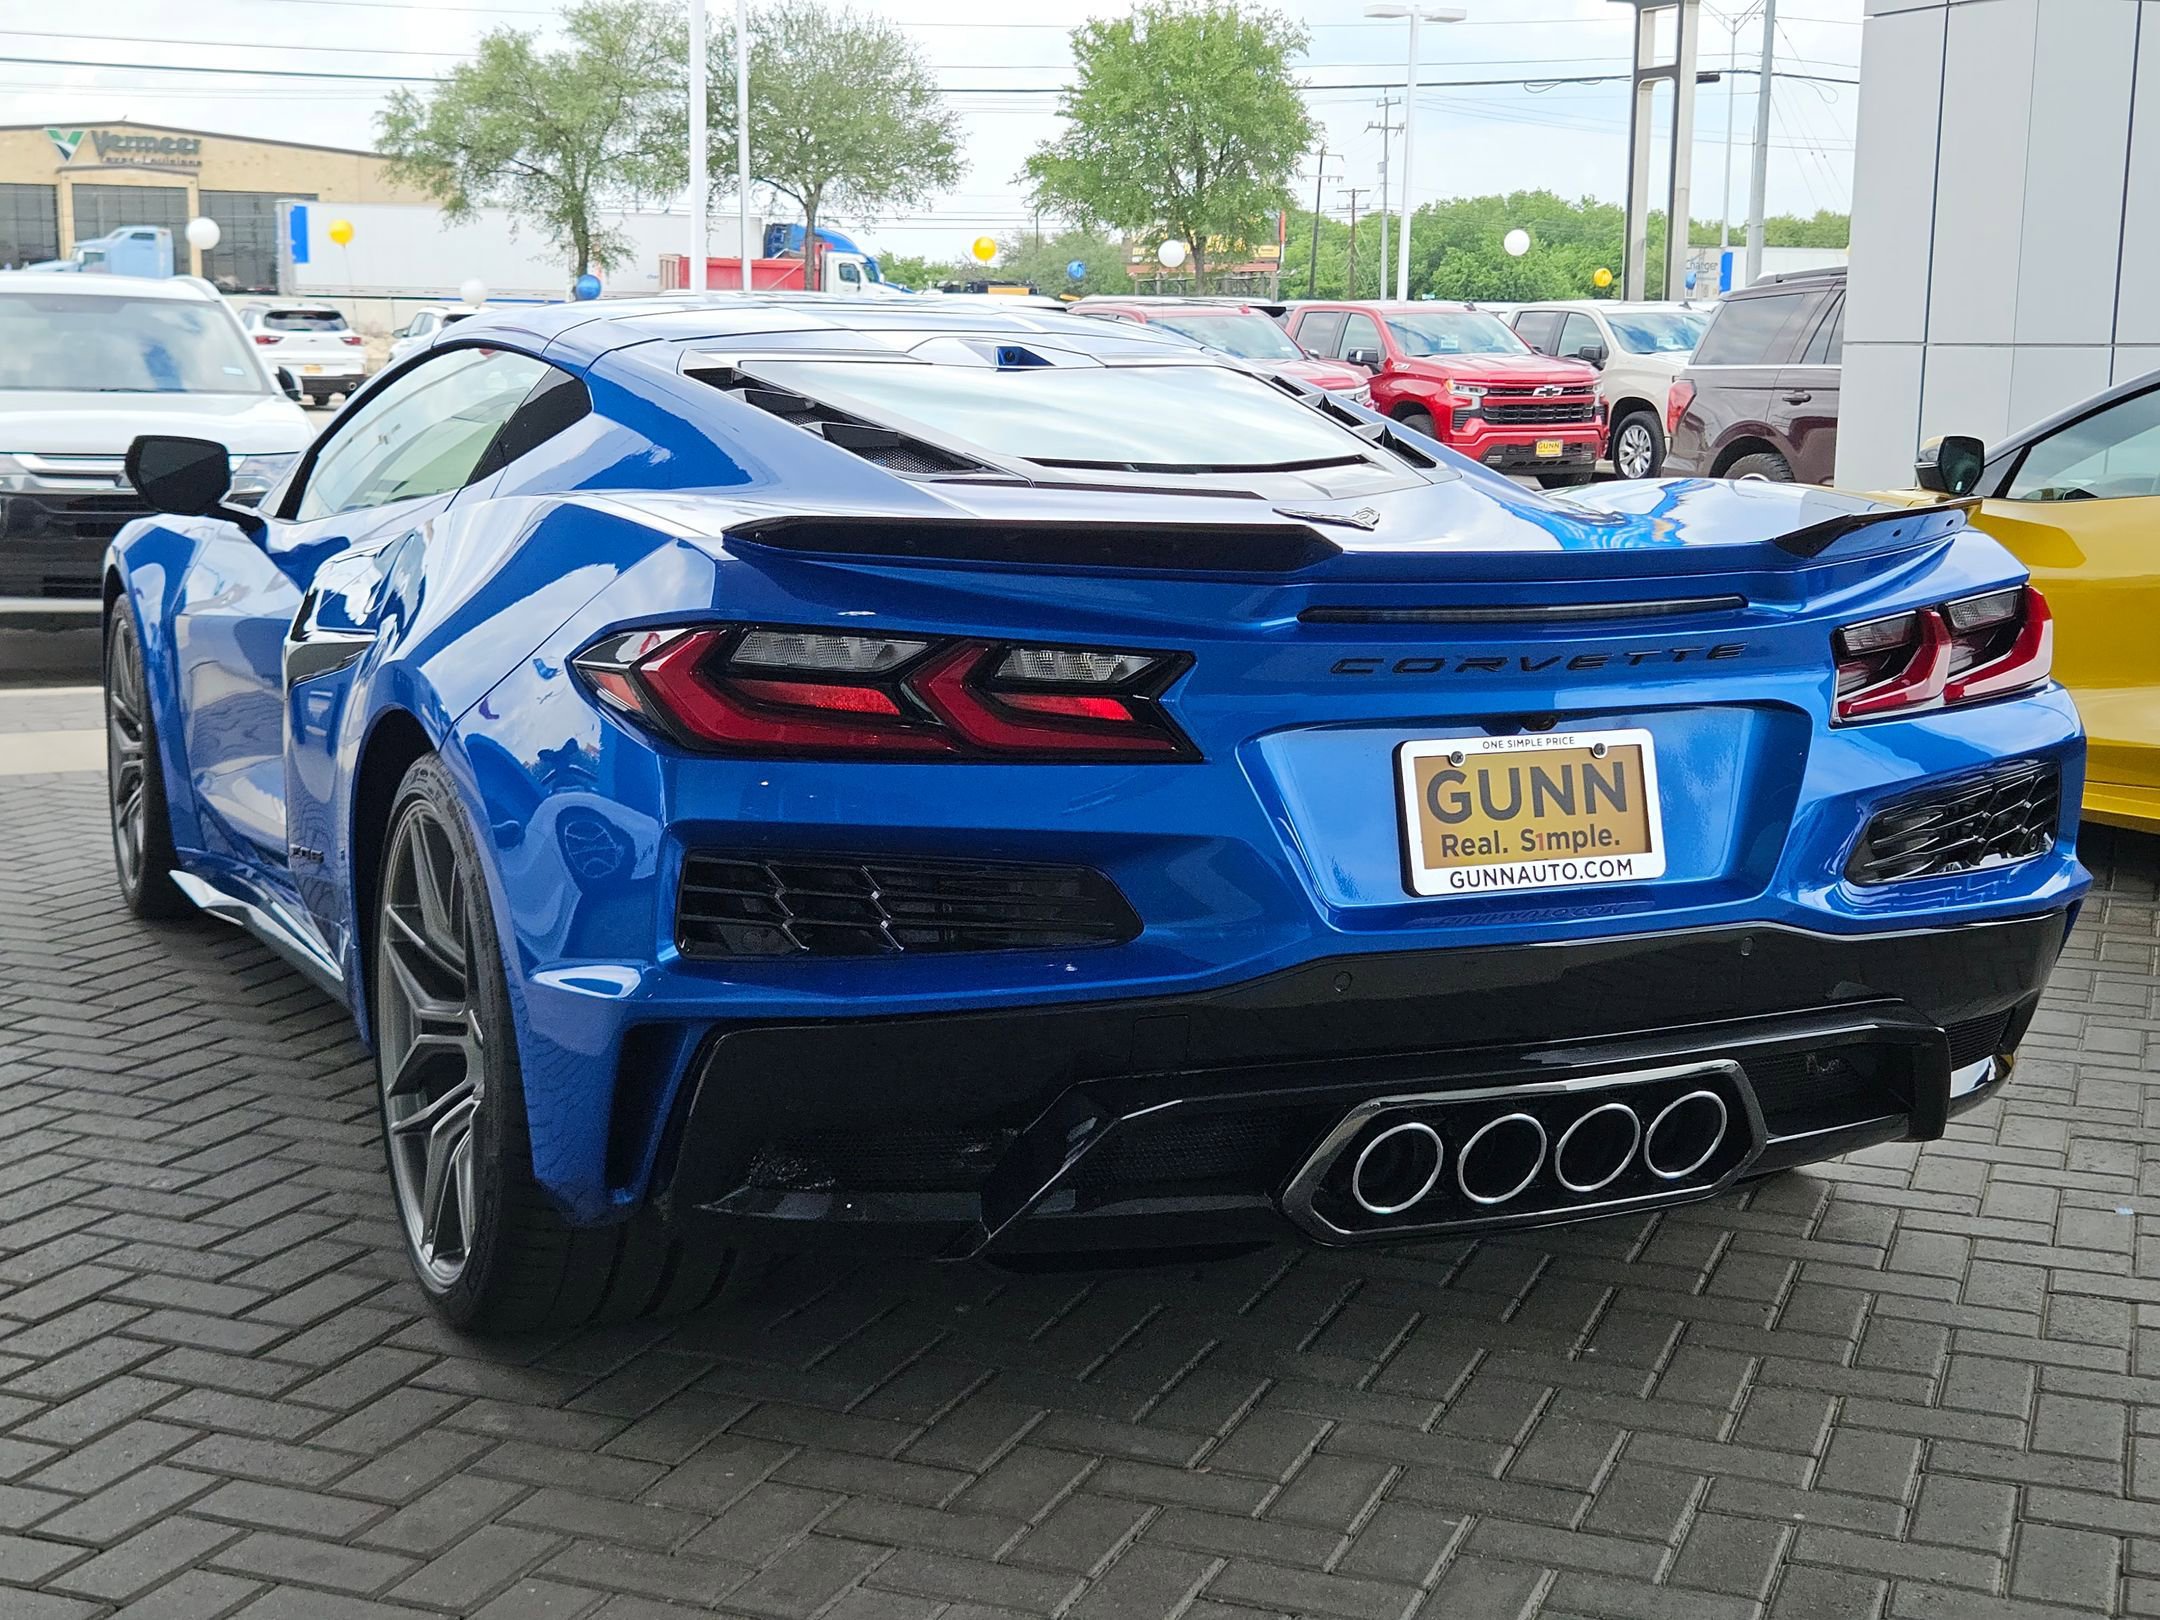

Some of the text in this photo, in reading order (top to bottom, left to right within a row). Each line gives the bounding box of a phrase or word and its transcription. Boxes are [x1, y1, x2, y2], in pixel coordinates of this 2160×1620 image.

[91, 130, 202, 157] Vermeer
[1537, 442, 1560, 450] GUNN
[1330, 641, 1750, 675] CORVETTE
[1482, 736, 1575, 750] ONE SIMPLE PRICE
[1426, 761, 1628, 824] GUNN
[1441, 830, 1508, 858] Real.
[1450, 858, 1634, 889] GUNNAUTO.COM
